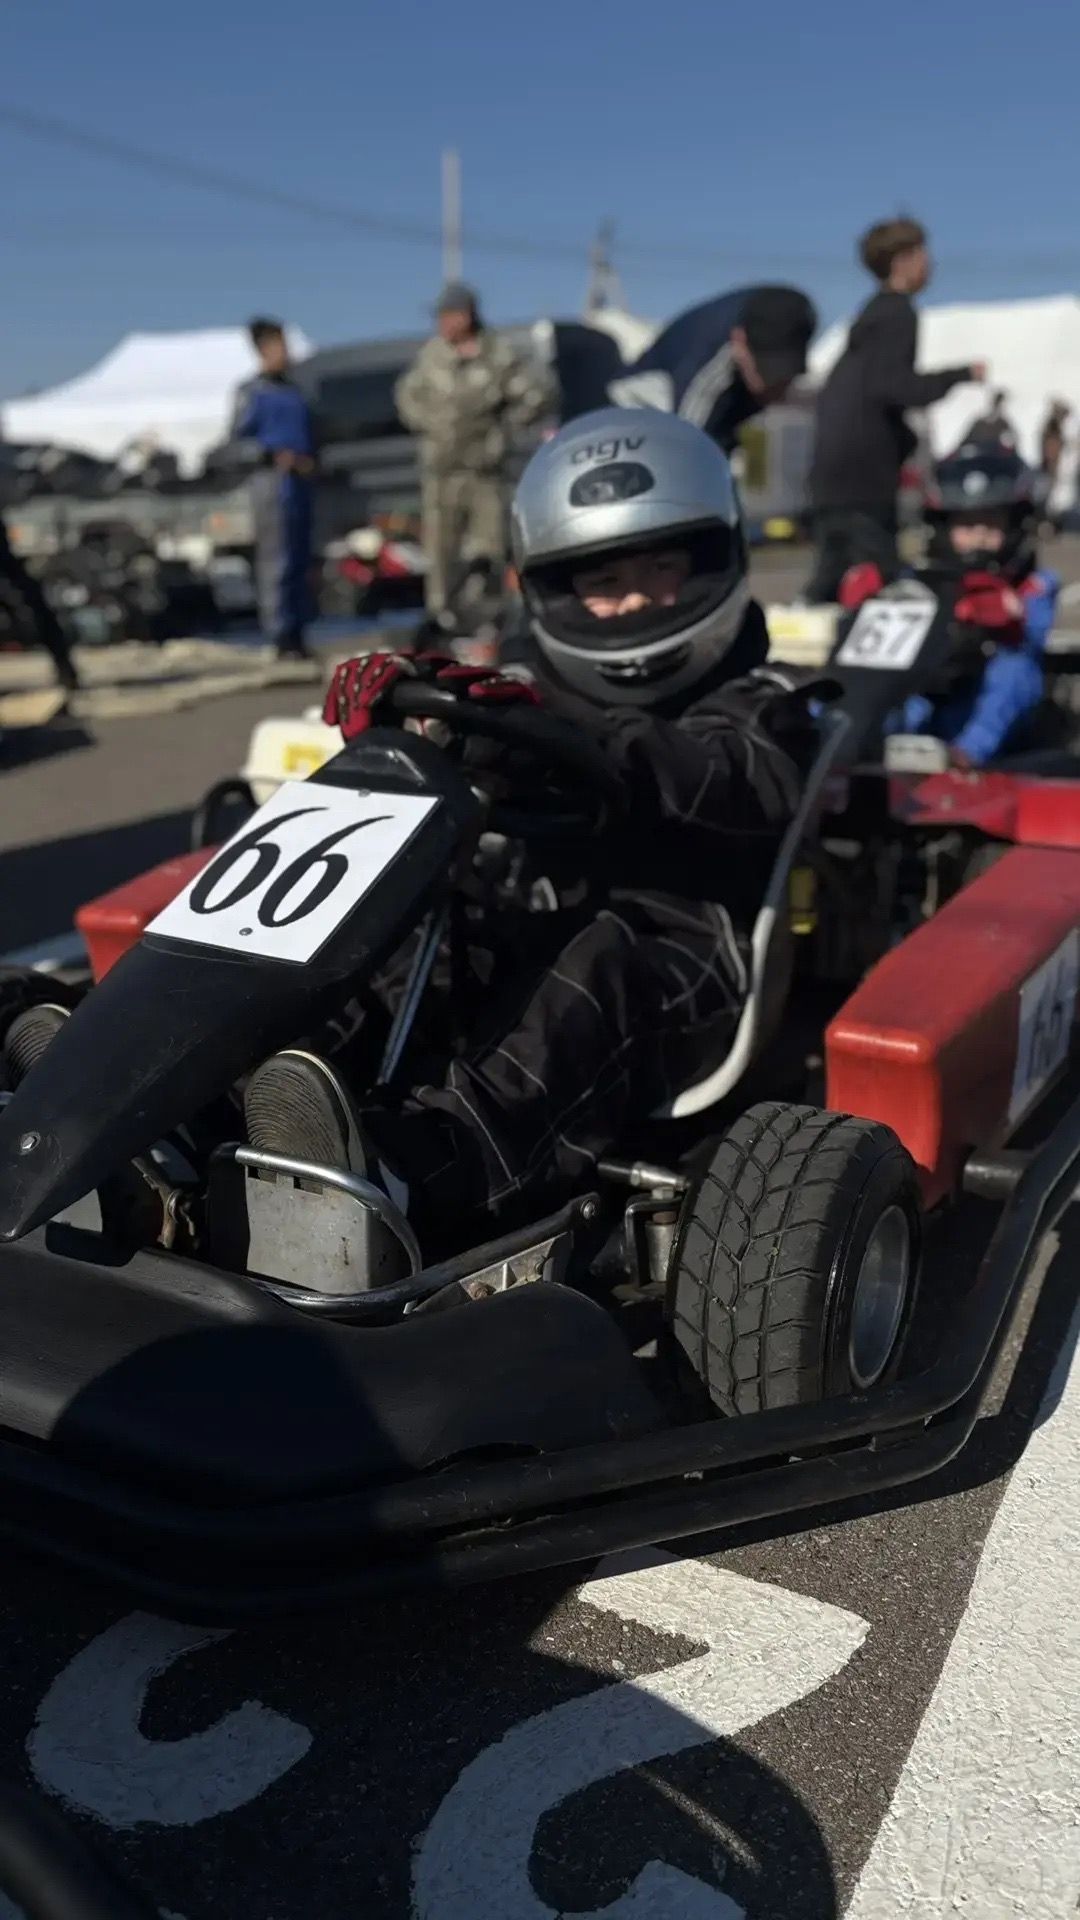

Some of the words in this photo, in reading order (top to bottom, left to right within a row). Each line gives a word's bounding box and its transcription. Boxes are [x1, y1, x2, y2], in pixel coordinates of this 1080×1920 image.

[571, 436, 647, 465] agv
[850, 610, 925, 657] 67
[189, 806, 395, 928] 66
